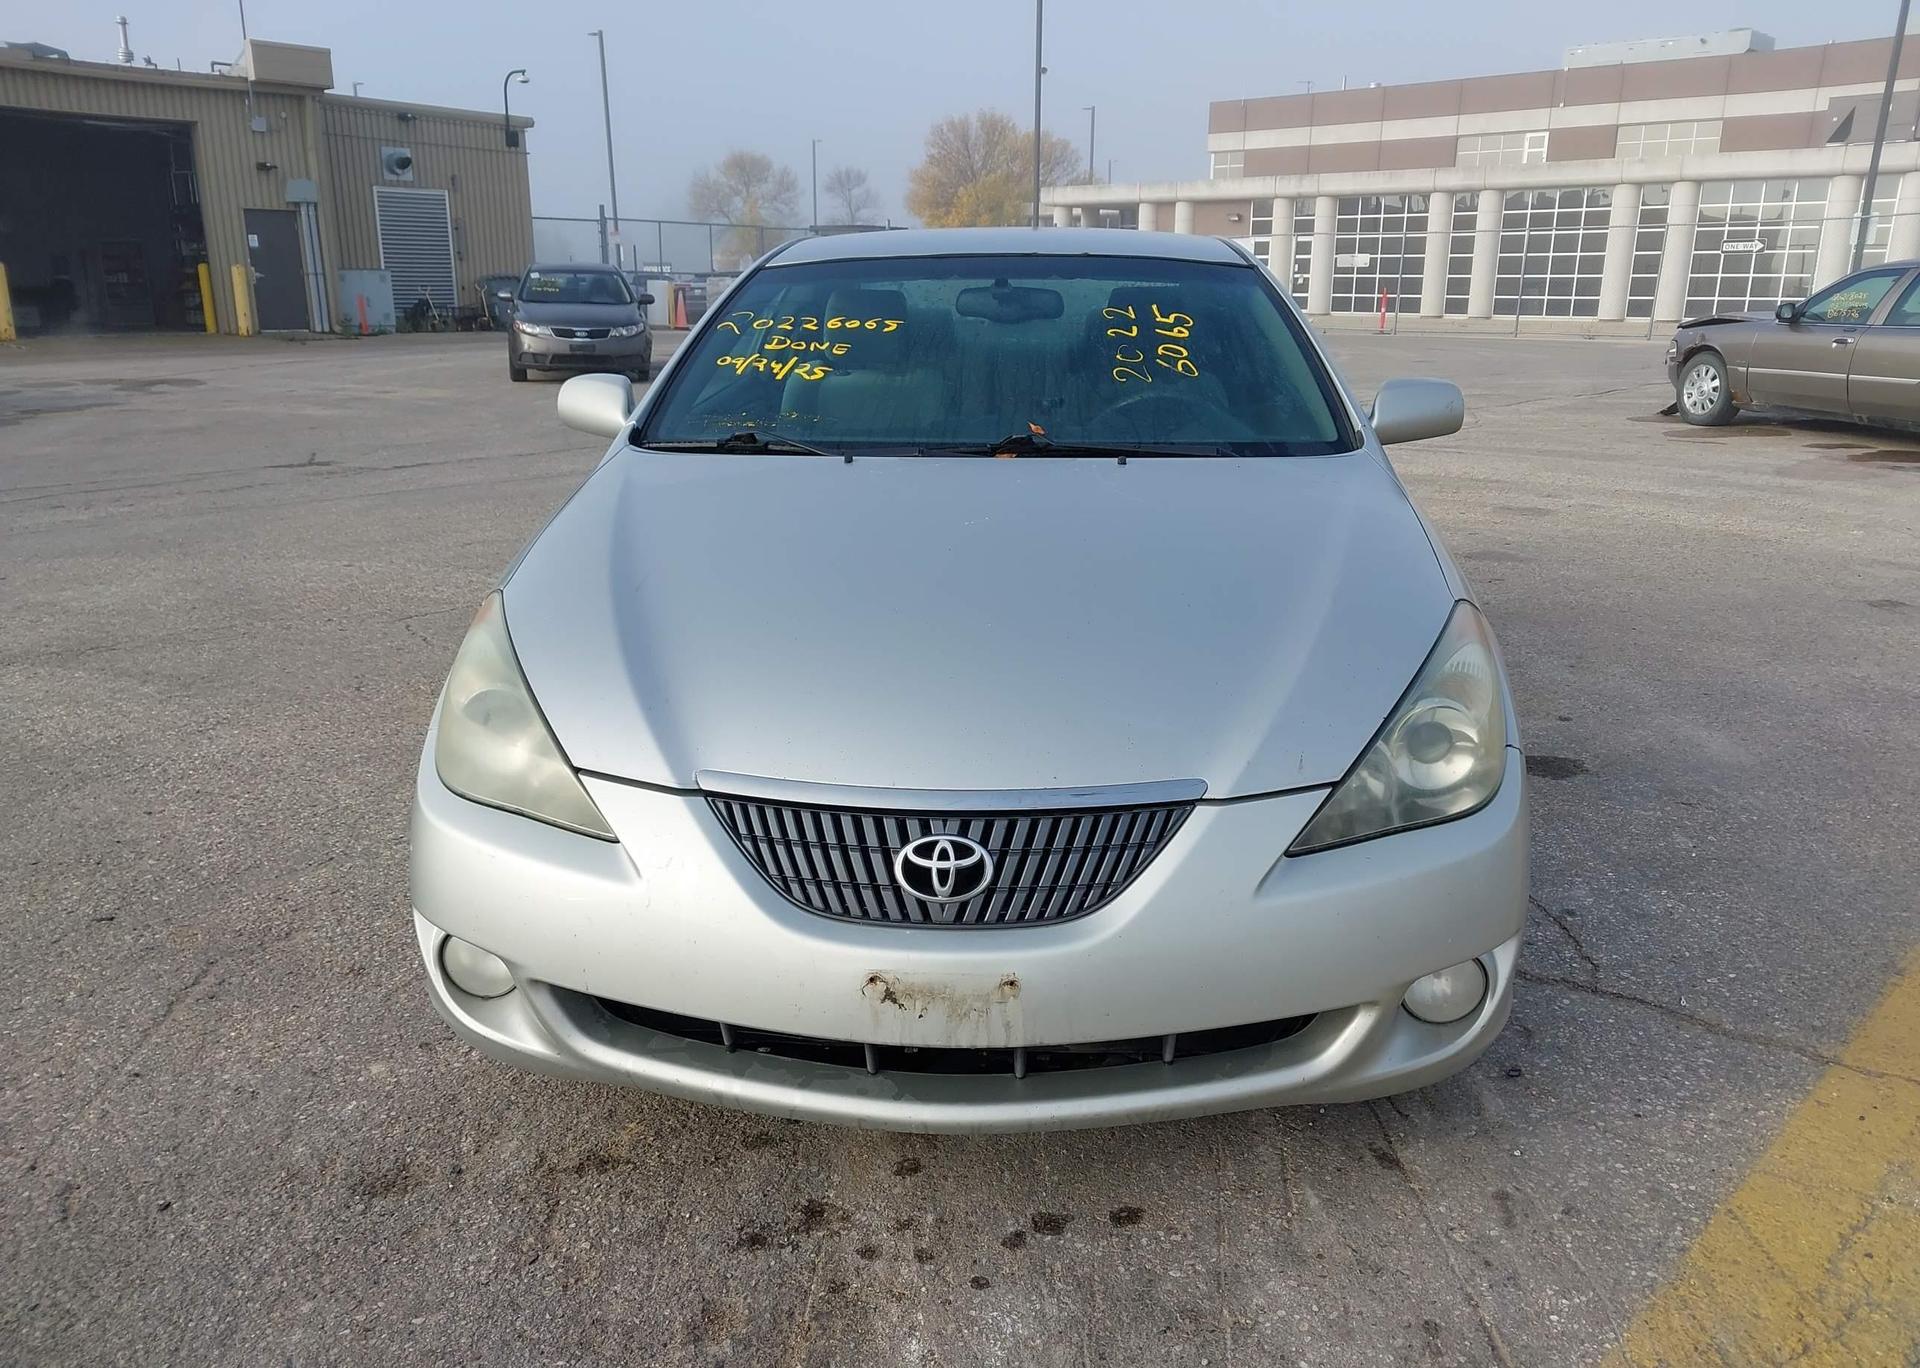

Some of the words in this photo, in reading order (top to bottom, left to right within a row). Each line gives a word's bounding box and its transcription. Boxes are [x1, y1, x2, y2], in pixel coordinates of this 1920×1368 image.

[1743, 242, 1758, 250] WAY
[716, 311, 904, 335] 20226065
[764, 335, 851, 355] DONE
[1102, 305, 1152, 383] 2022
[1151, 304, 1198, 377] 6065
